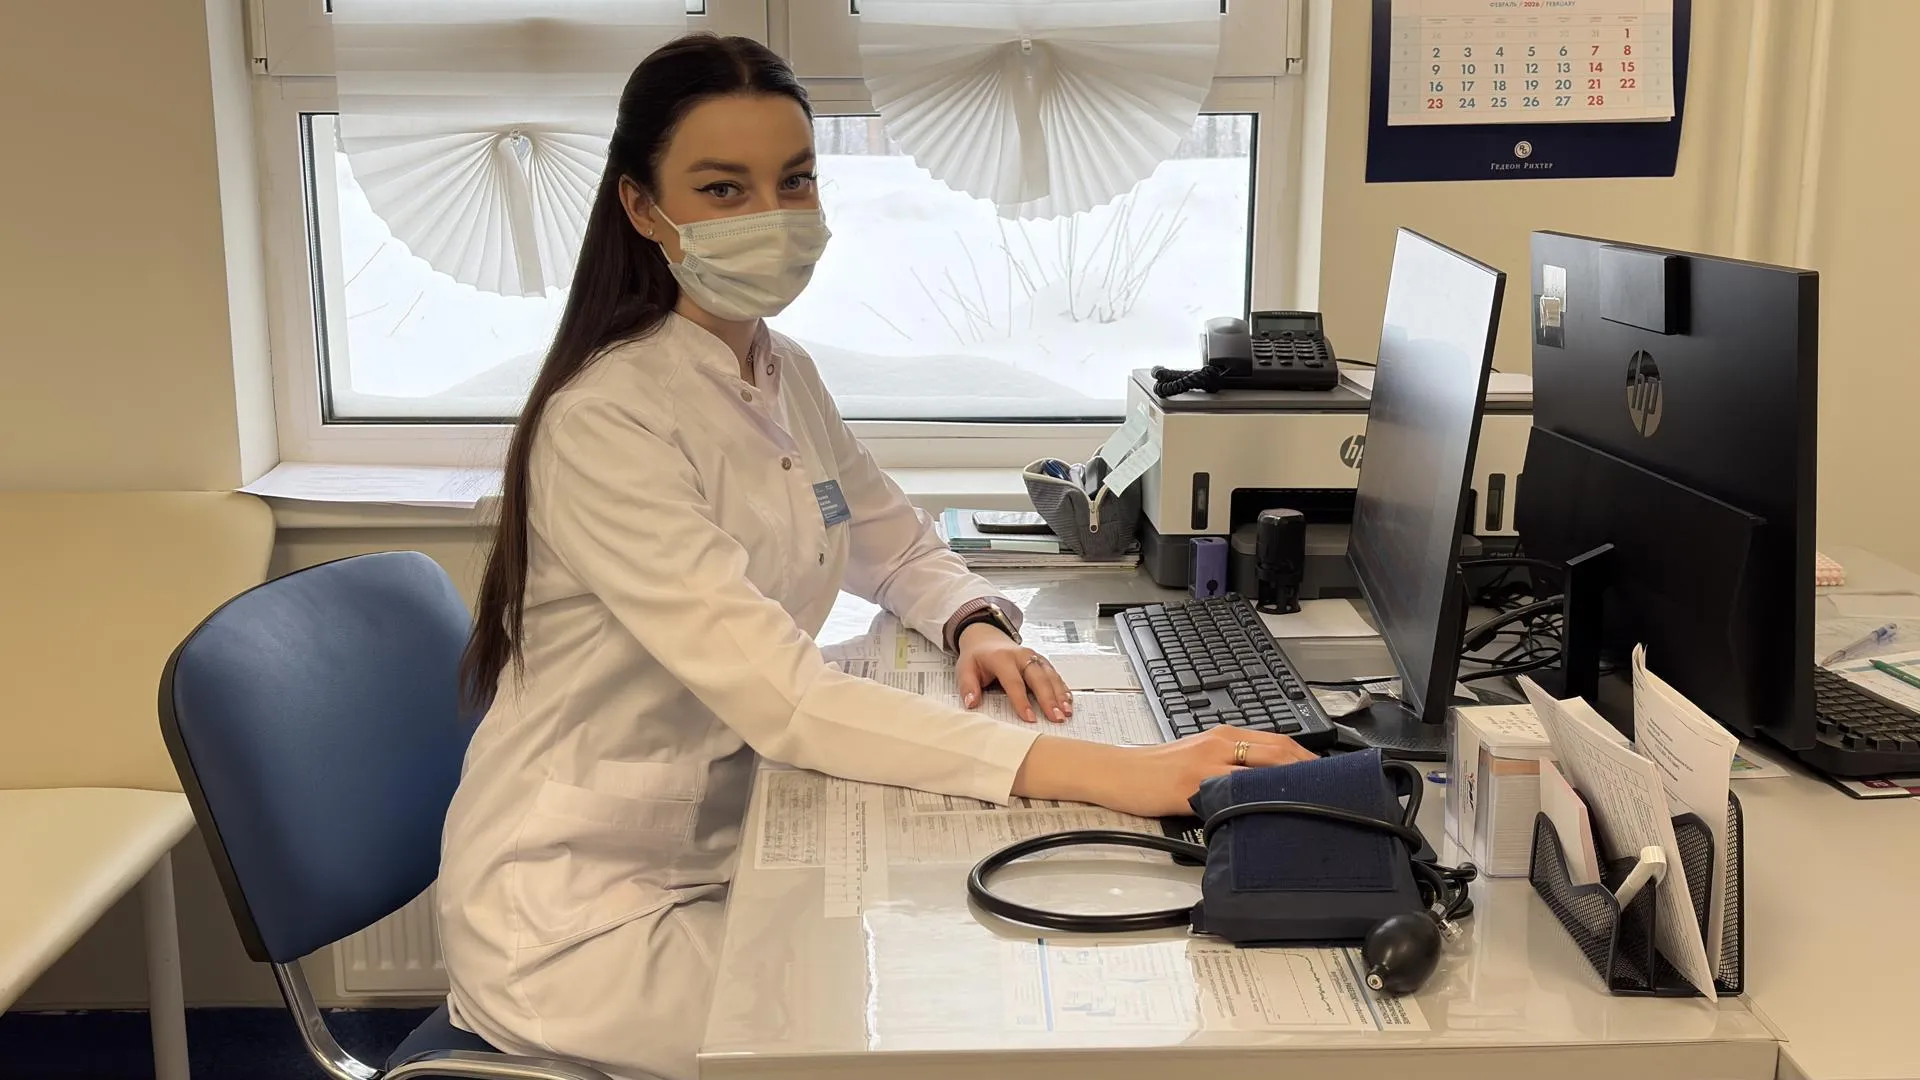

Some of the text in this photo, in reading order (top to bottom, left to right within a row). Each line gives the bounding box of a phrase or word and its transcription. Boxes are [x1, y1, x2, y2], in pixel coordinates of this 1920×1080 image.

[1624, 28, 1630, 38] 1
[1432, 45, 1632, 58] 2 3 4 5 6 7 8
[1432, 61, 1635, 75] 9 10 11 12 13 14 15
[1429, 78, 1636, 92] 16 17 18 19 20 21 22
[1427, 95, 1604, 109] 23 24 25 26 27 28
[1490, 162, 1554, 171] ГЕДЕОН РИХТЕР
[1630, 349, 1661, 438] hp
